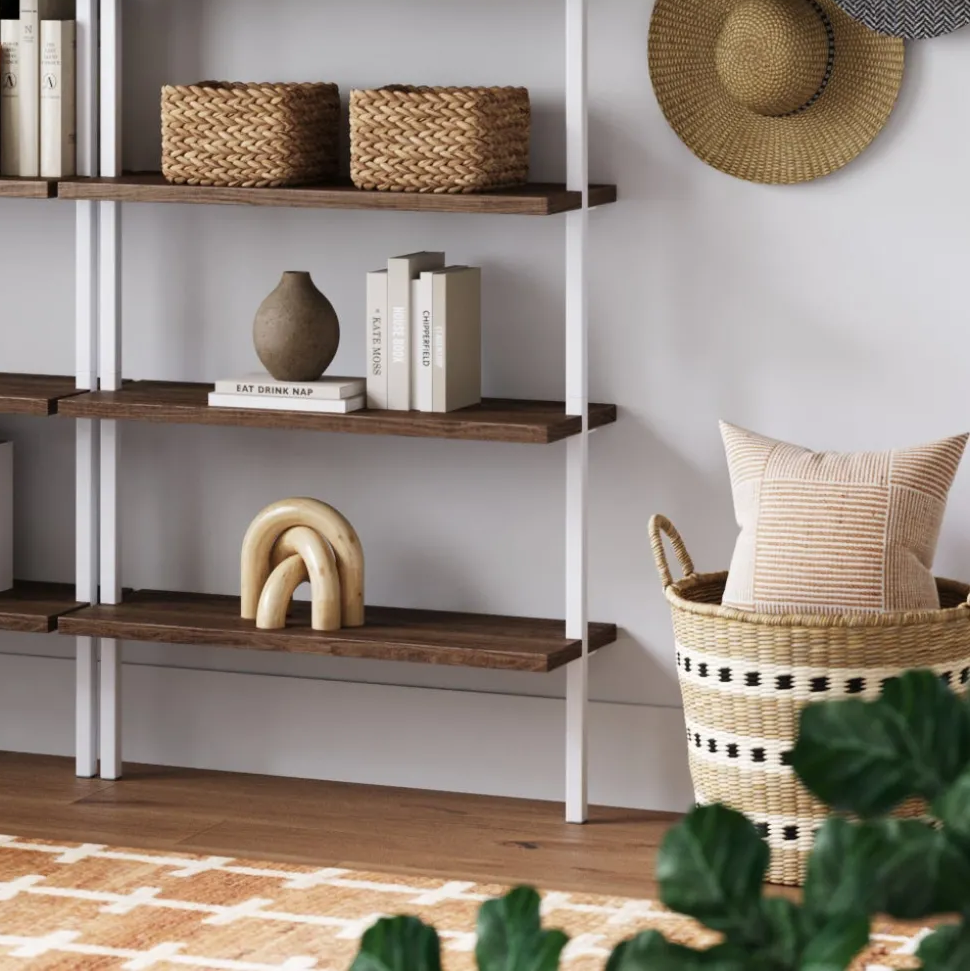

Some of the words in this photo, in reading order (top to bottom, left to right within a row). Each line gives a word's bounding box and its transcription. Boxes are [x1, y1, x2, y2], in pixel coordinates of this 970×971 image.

[372, 316, 382, 345] KATE
[392, 307, 406, 337] HOUSE
[392, 338, 406, 364] BOOK
[422, 310, 431, 367] CHIPPERFIELD
[372, 347, 382, 376] MOSS
[236, 384, 254, 393] EAT
[257, 385, 290, 396] DRINK
[292, 387, 314, 397] NAP
